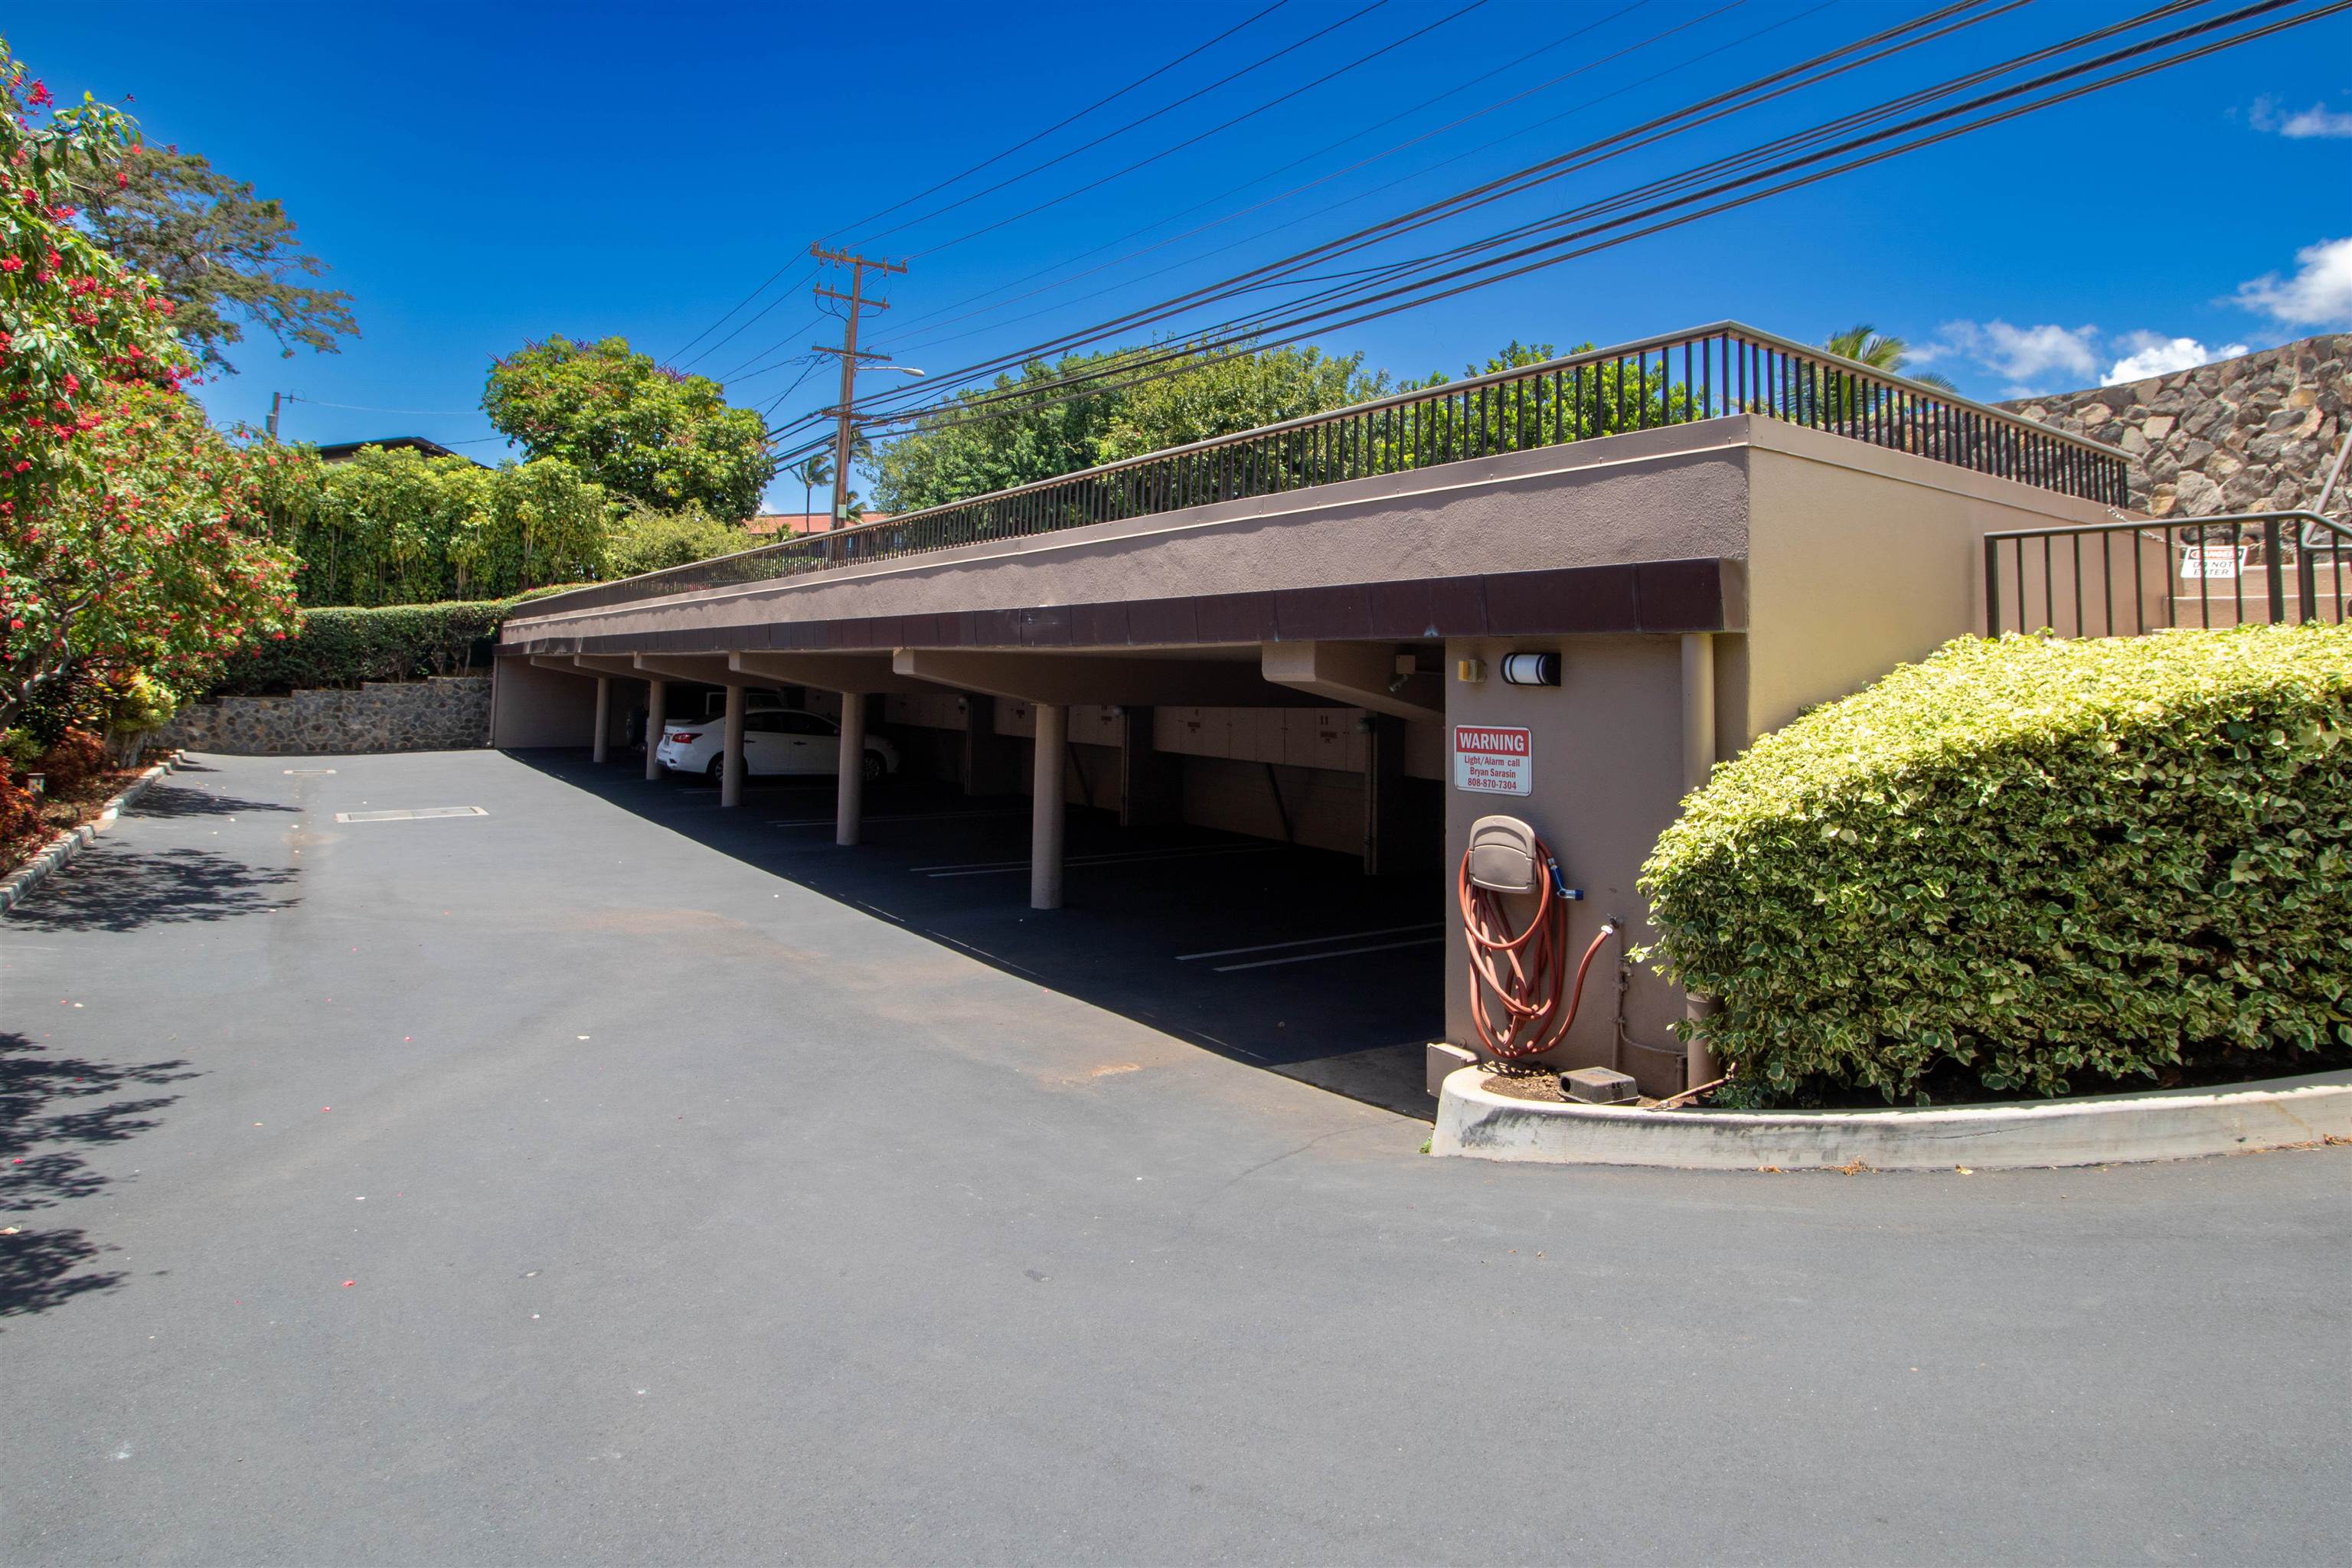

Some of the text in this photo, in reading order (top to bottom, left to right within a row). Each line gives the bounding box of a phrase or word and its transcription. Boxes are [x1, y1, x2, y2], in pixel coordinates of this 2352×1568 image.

[1320, 715, 1328, 725] 11
[1459, 733, 1524, 752] WARNING
[1464, 755, 1521, 767] Light/Alarm call
[1470, 767, 1516, 779] Bryan Sarasin
[1468, 778, 1517, 789] 808-870-7304
